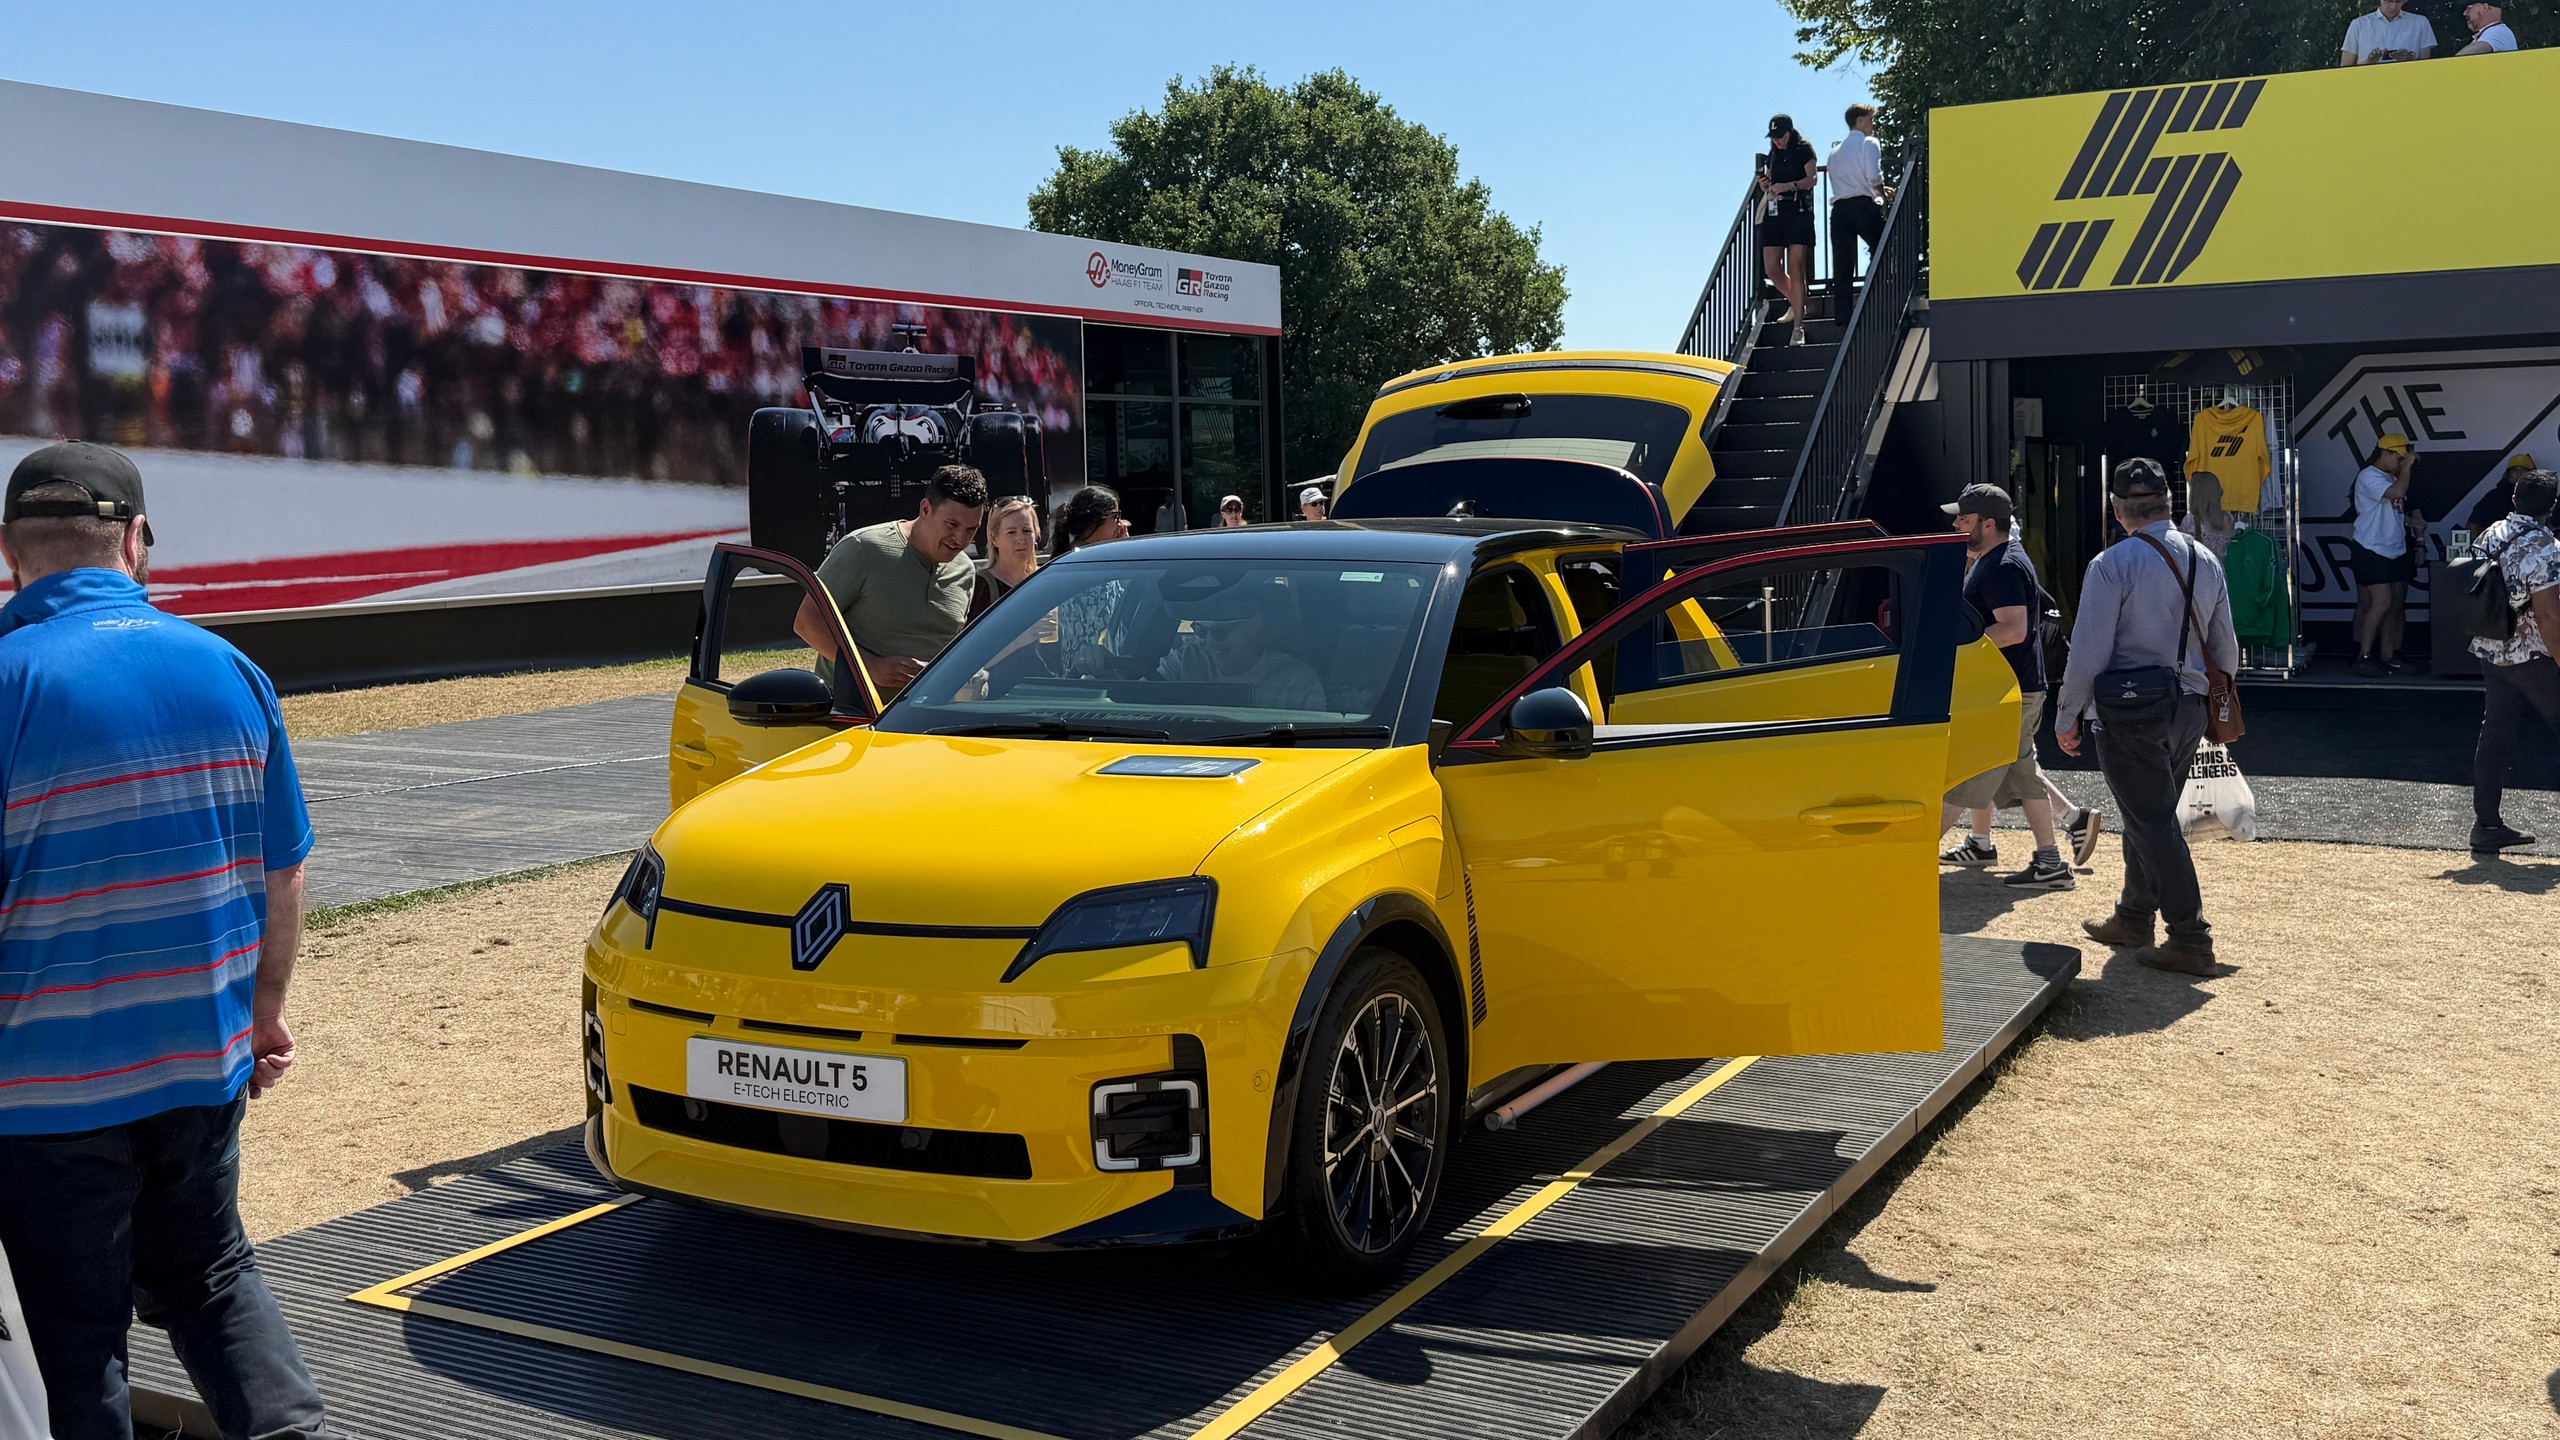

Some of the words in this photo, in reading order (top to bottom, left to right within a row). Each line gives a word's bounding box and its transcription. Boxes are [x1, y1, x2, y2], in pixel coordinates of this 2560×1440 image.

[1111, 259, 1162, 278] MoneyGram
[1204, 272, 1233, 282] TOYOTA
[1111, 278, 1132, 288] HAAS
[1143, 281, 1163, 291] TEAM
[1203, 281, 1230, 291] GAZOO
[1203, 289, 1229, 301] Racing
[848, 361, 887, 371] TOYOTA
[889, 363, 923, 373] GAZOO
[924, 365, 954, 374] Racing
[2327, 383, 2467, 469] THE
[717, 1049, 846, 1088] RENAULT
[851, 1065, 868, 1091] 5
[733, 1082, 780, 1101] E-TECH
[783, 1088, 850, 1109] ELECTRIC
